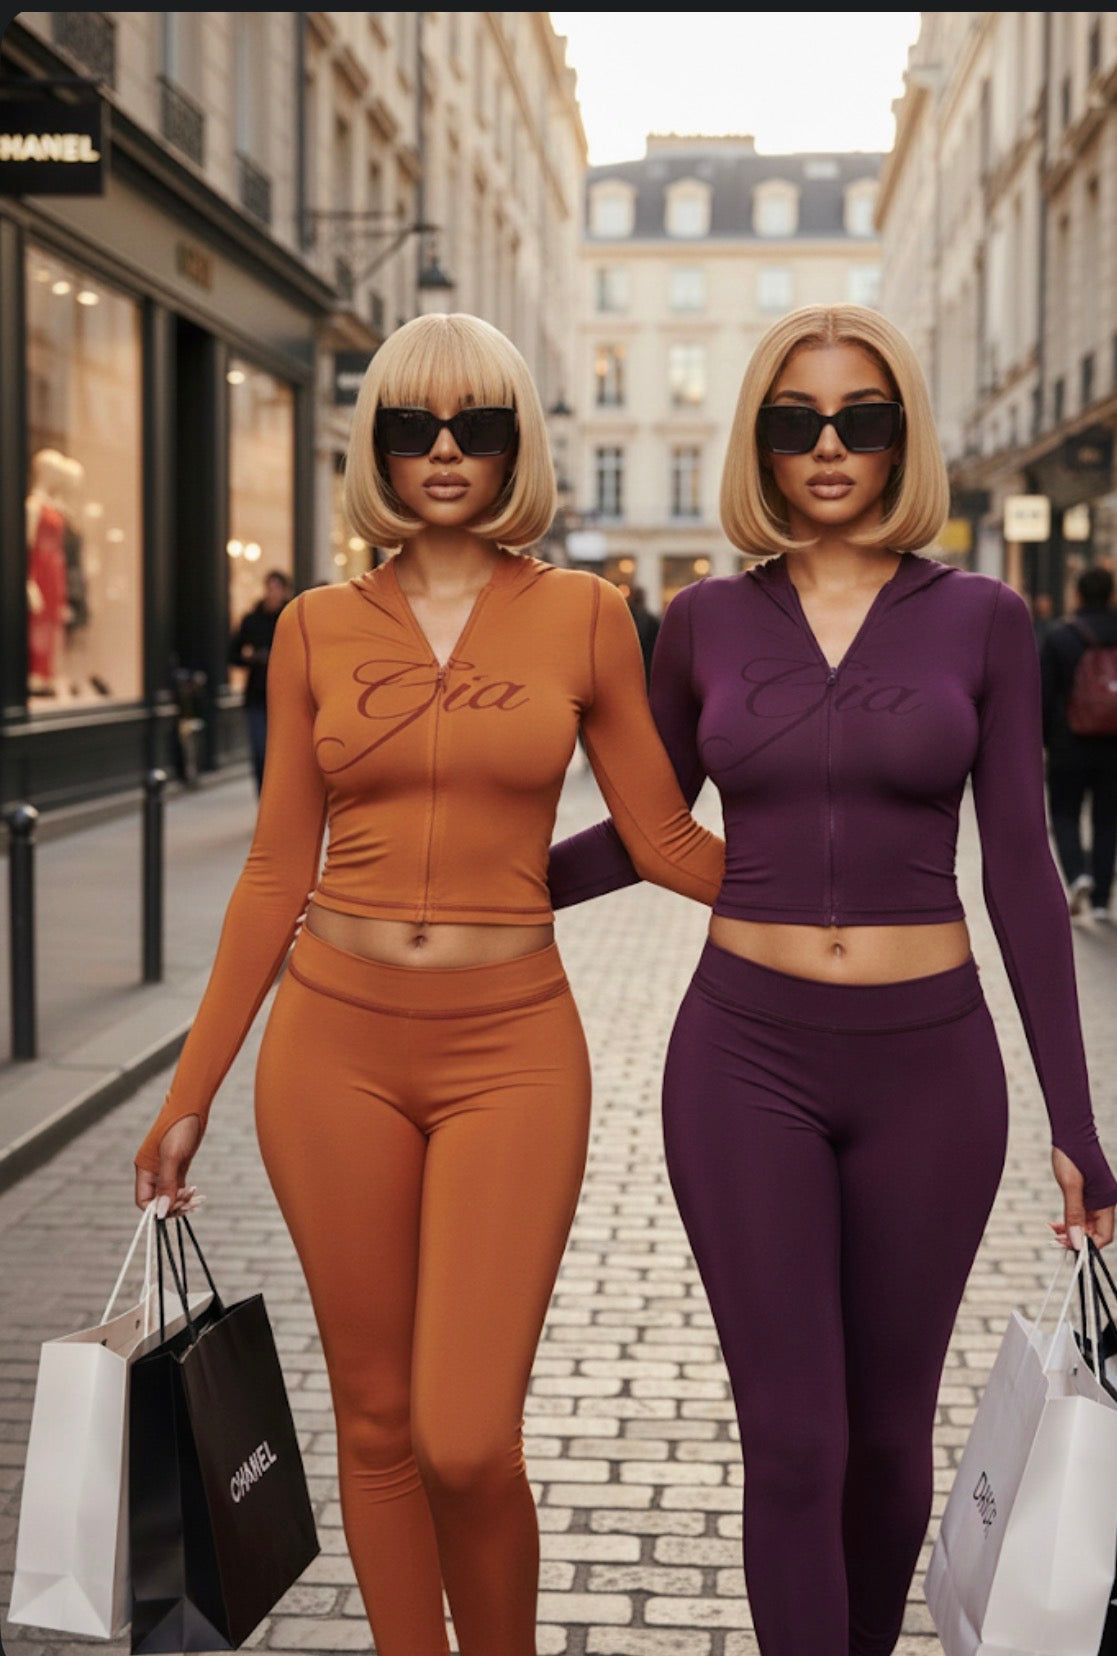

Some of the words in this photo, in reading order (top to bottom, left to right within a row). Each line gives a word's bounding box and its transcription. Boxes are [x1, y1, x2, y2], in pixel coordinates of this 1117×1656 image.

[0, 133, 101, 163] HANEL
[315, 656, 530, 775] Gia
[701, 656, 924, 774] Gia
